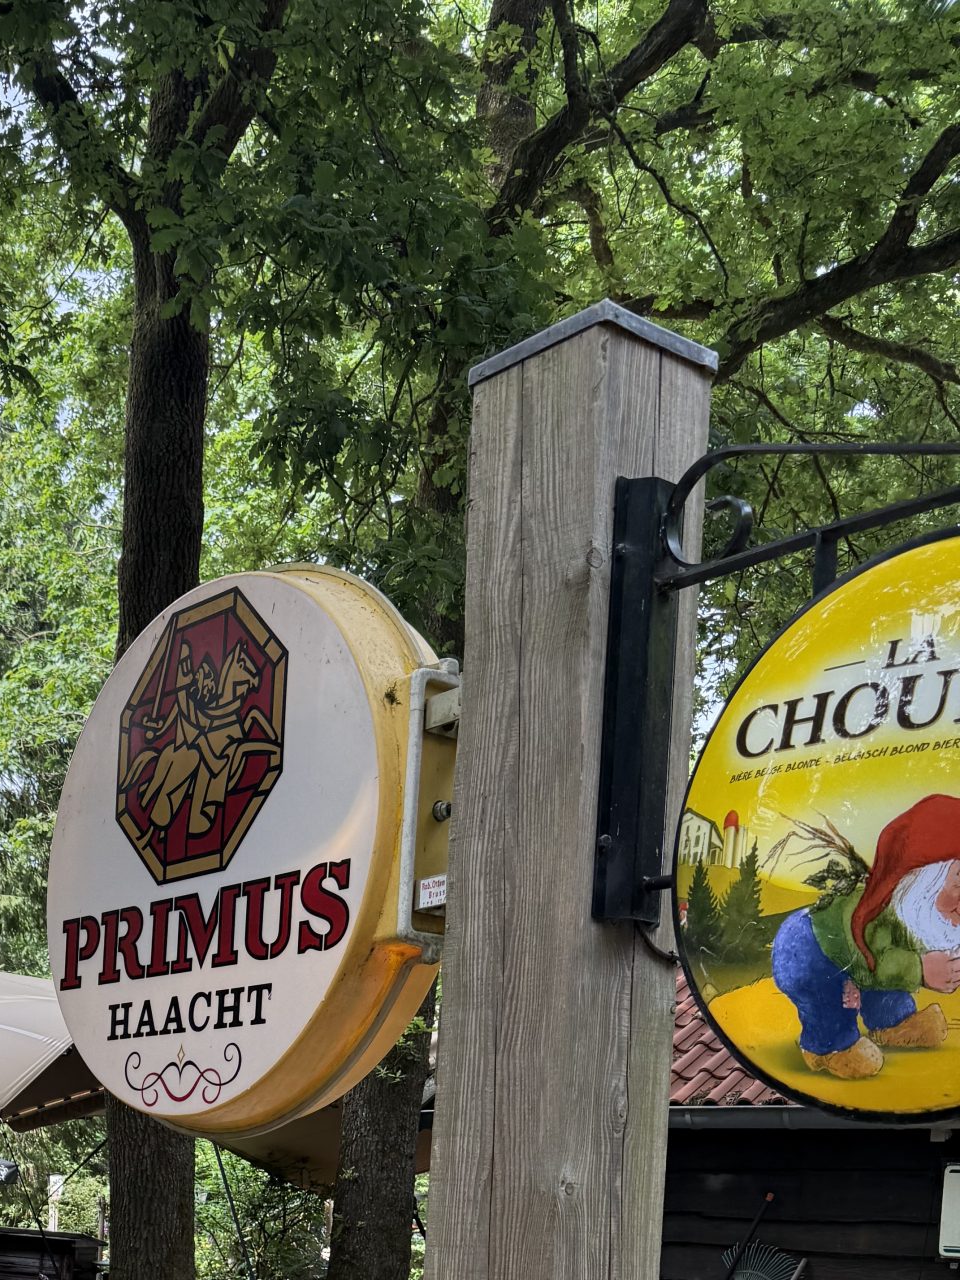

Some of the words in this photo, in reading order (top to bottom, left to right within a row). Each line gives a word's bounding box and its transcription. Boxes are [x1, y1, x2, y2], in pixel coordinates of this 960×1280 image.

[882, 634, 941, 669] LA
[736, 668, 960, 758] CHOU
[785, 757, 822, 772] BLONDE
[834, 745, 889, 764] BELGISCH
[889, 742, 931, 757] BLOND
[932, 737, 960, 751] BIER
[60, 858, 351, 991] PRIMUS
[107, 983, 272, 1041] HAACHT
